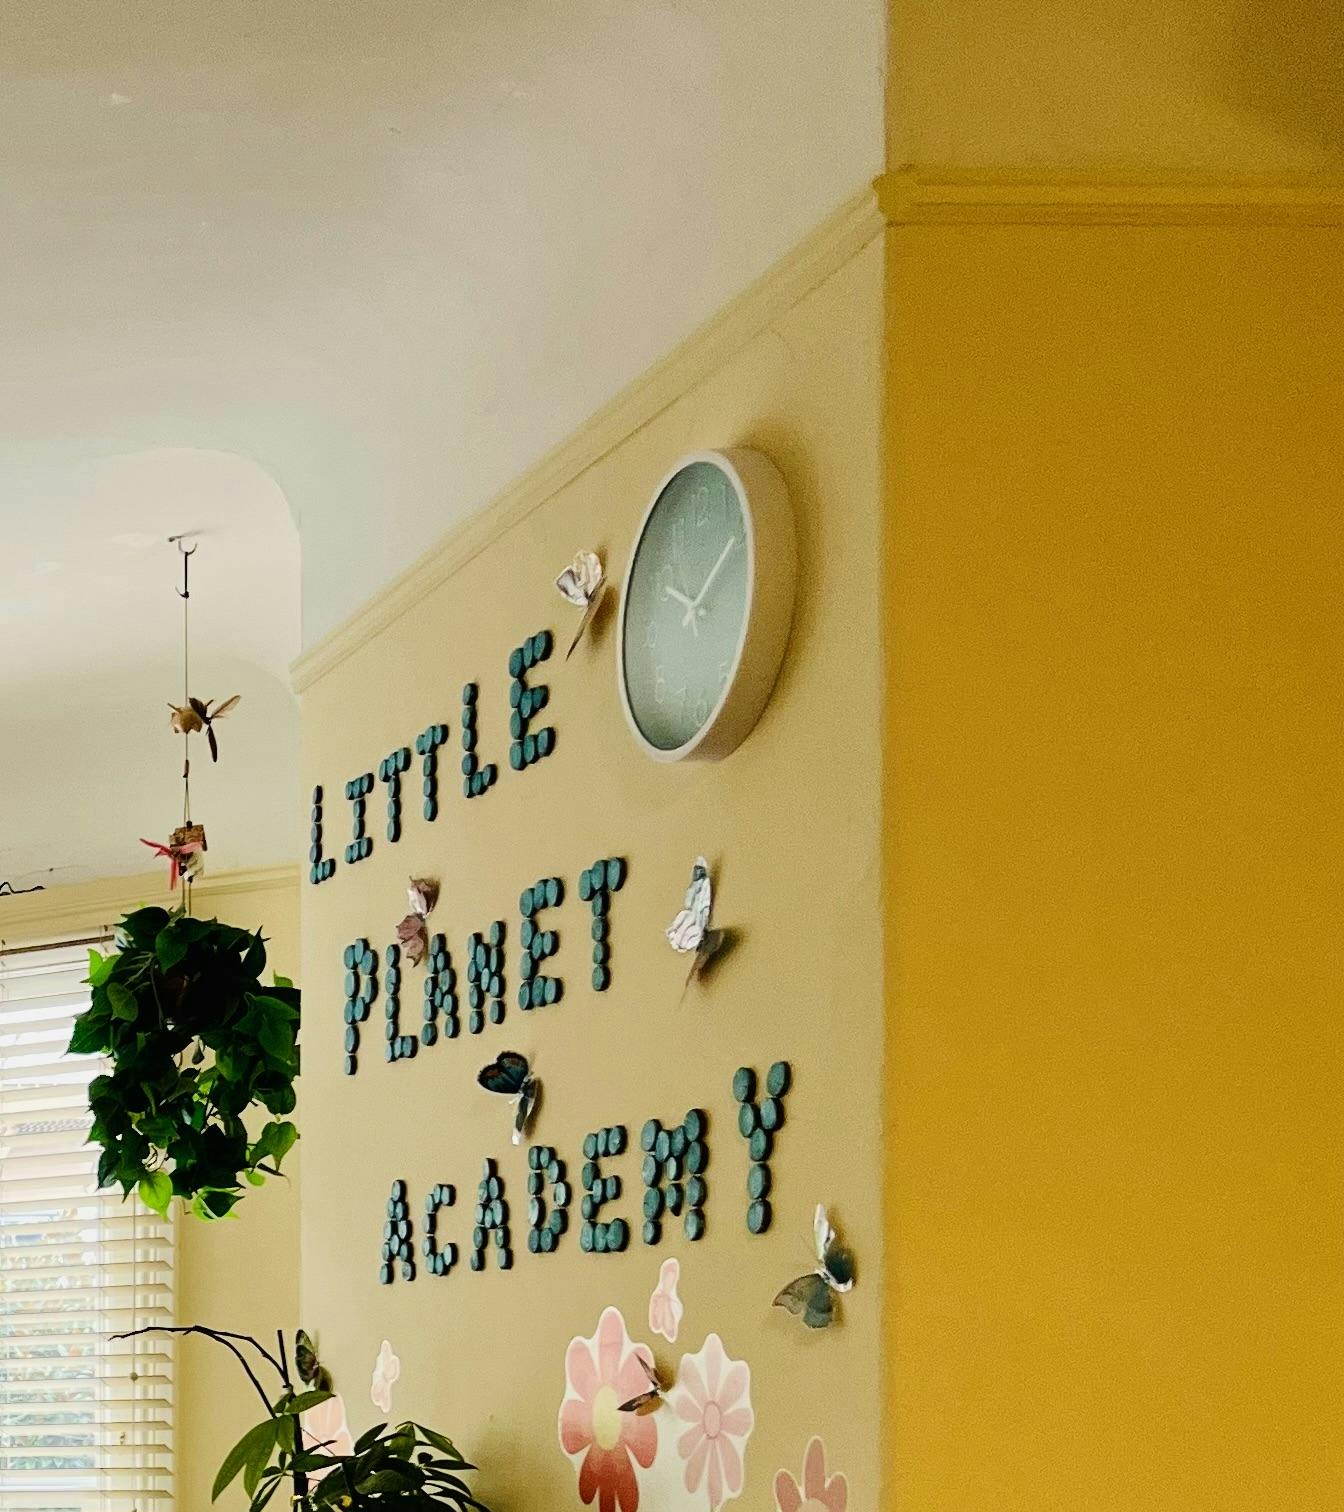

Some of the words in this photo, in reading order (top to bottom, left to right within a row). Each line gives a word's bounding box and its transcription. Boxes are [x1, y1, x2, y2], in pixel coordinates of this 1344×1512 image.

[309, 630, 556, 884] LITTLE
[343, 857, 627, 1075] PLANET
[380, 1061, 792, 1285] ACADEMY
